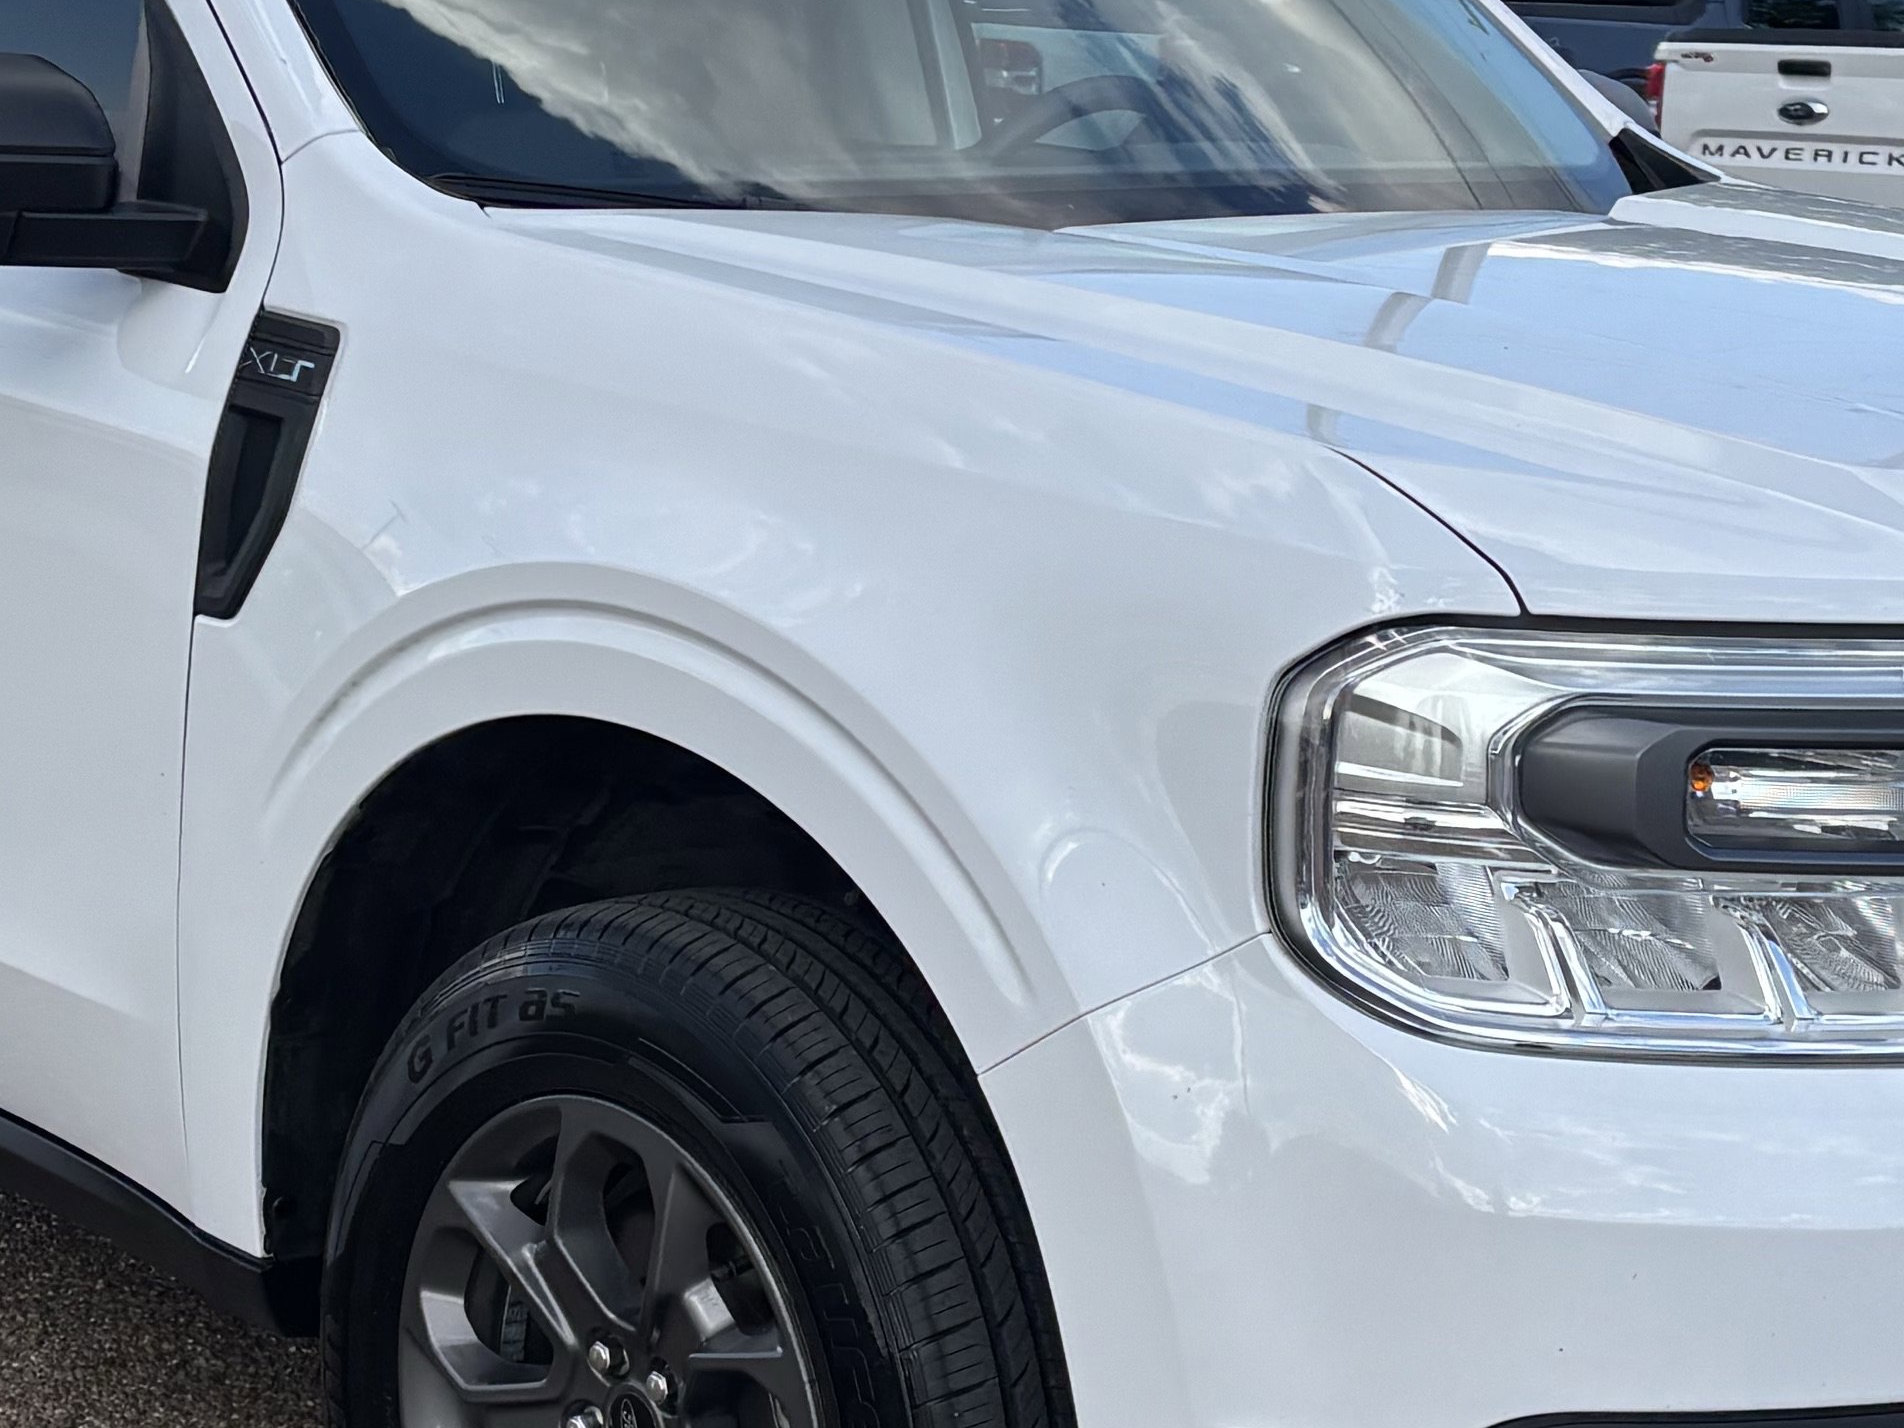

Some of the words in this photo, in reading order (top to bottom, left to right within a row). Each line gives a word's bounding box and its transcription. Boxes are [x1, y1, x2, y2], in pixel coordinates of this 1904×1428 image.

[239, 346, 315, 383] XLT
[406, 1033, 434, 1085] G
[445, 993, 508, 1052] FIT
